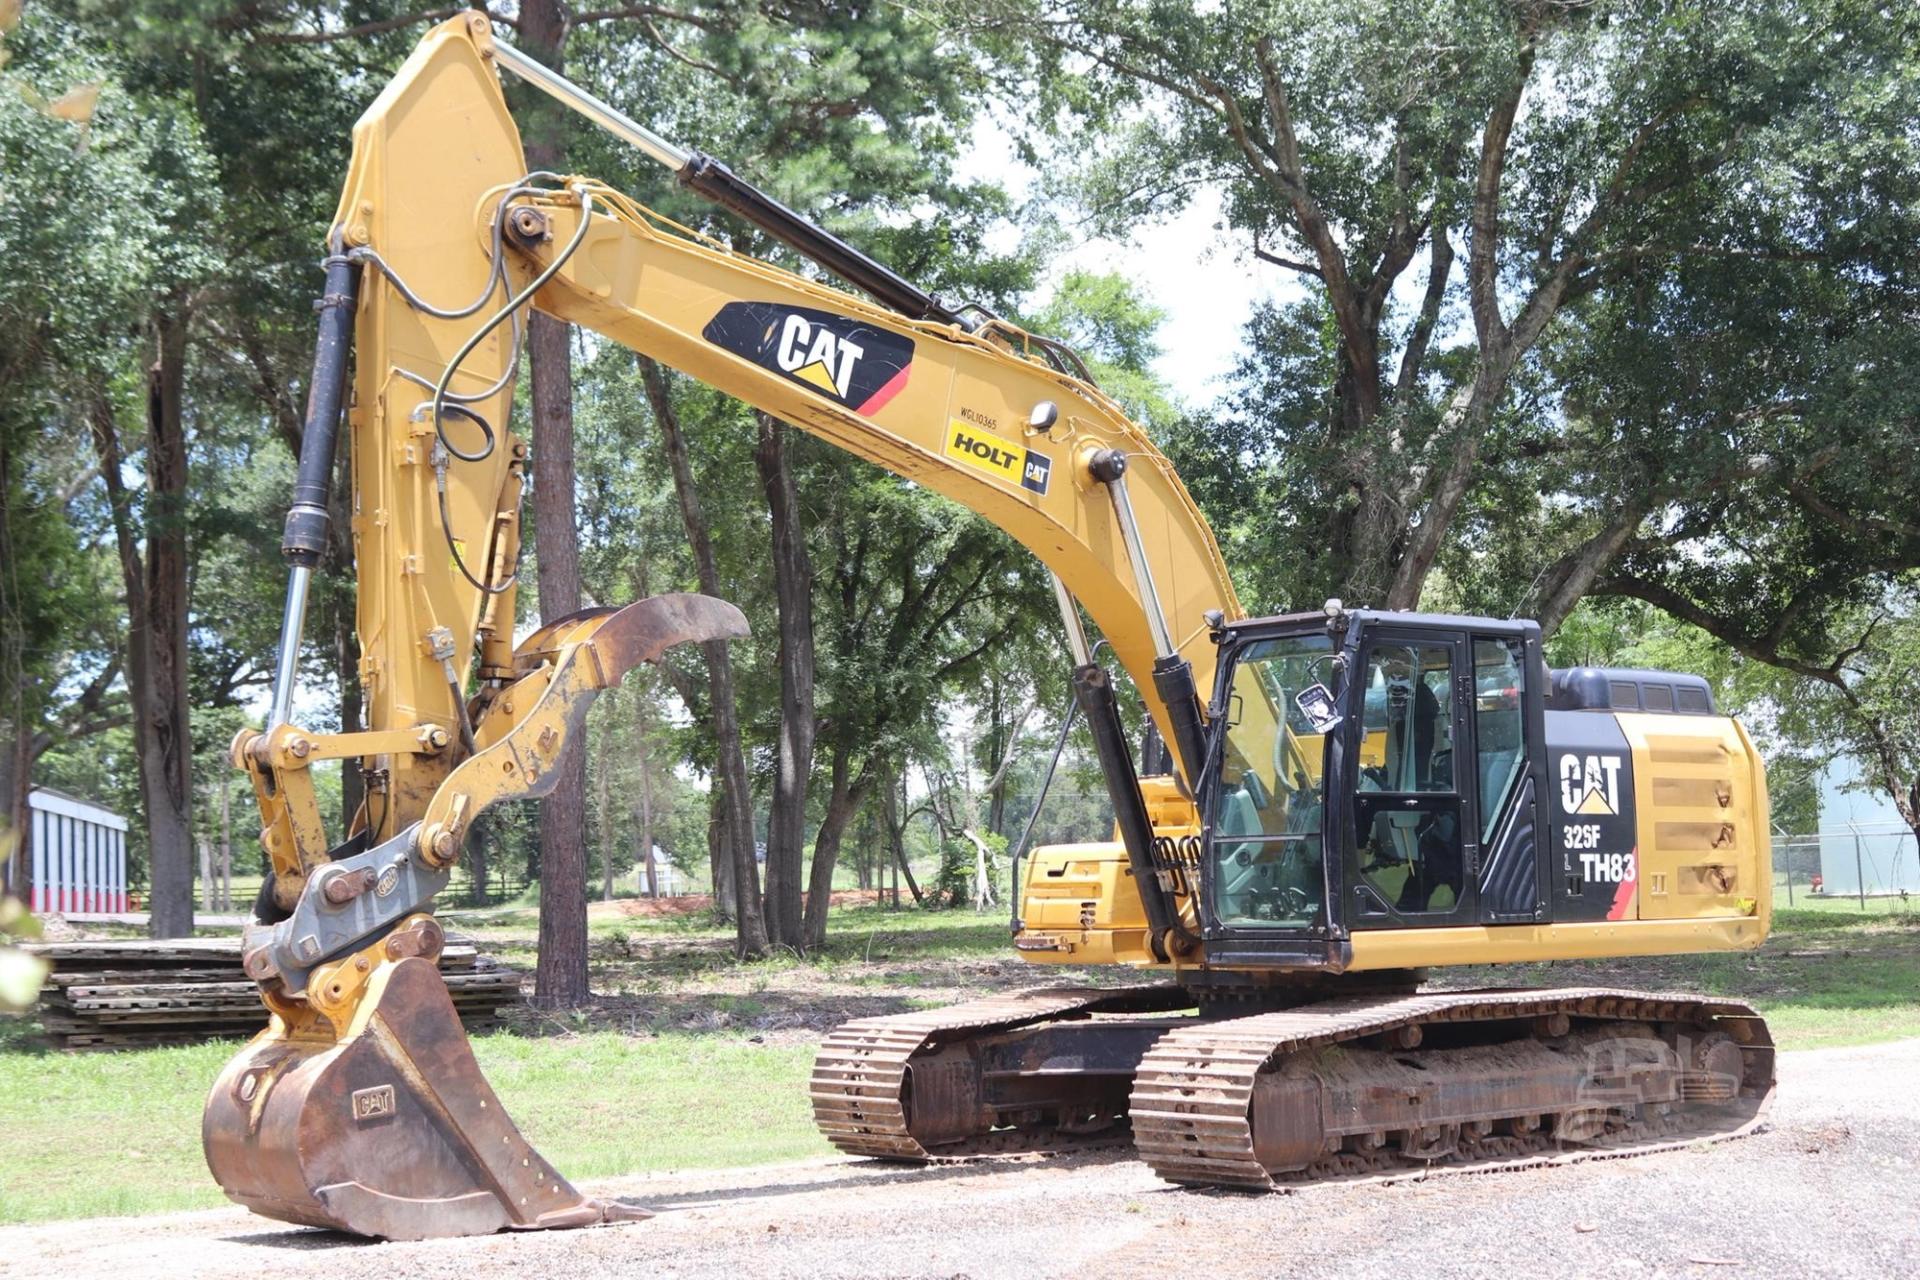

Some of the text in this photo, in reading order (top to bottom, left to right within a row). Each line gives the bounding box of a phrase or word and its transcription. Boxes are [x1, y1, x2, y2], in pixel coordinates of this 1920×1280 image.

[777, 314, 864, 399] CAT
[954, 432, 1048, 484] HOLT CAT
[1560, 753, 1621, 816] CAT
[1579, 853, 1636, 882] TH83
[360, 1091, 388, 1117] CAT
